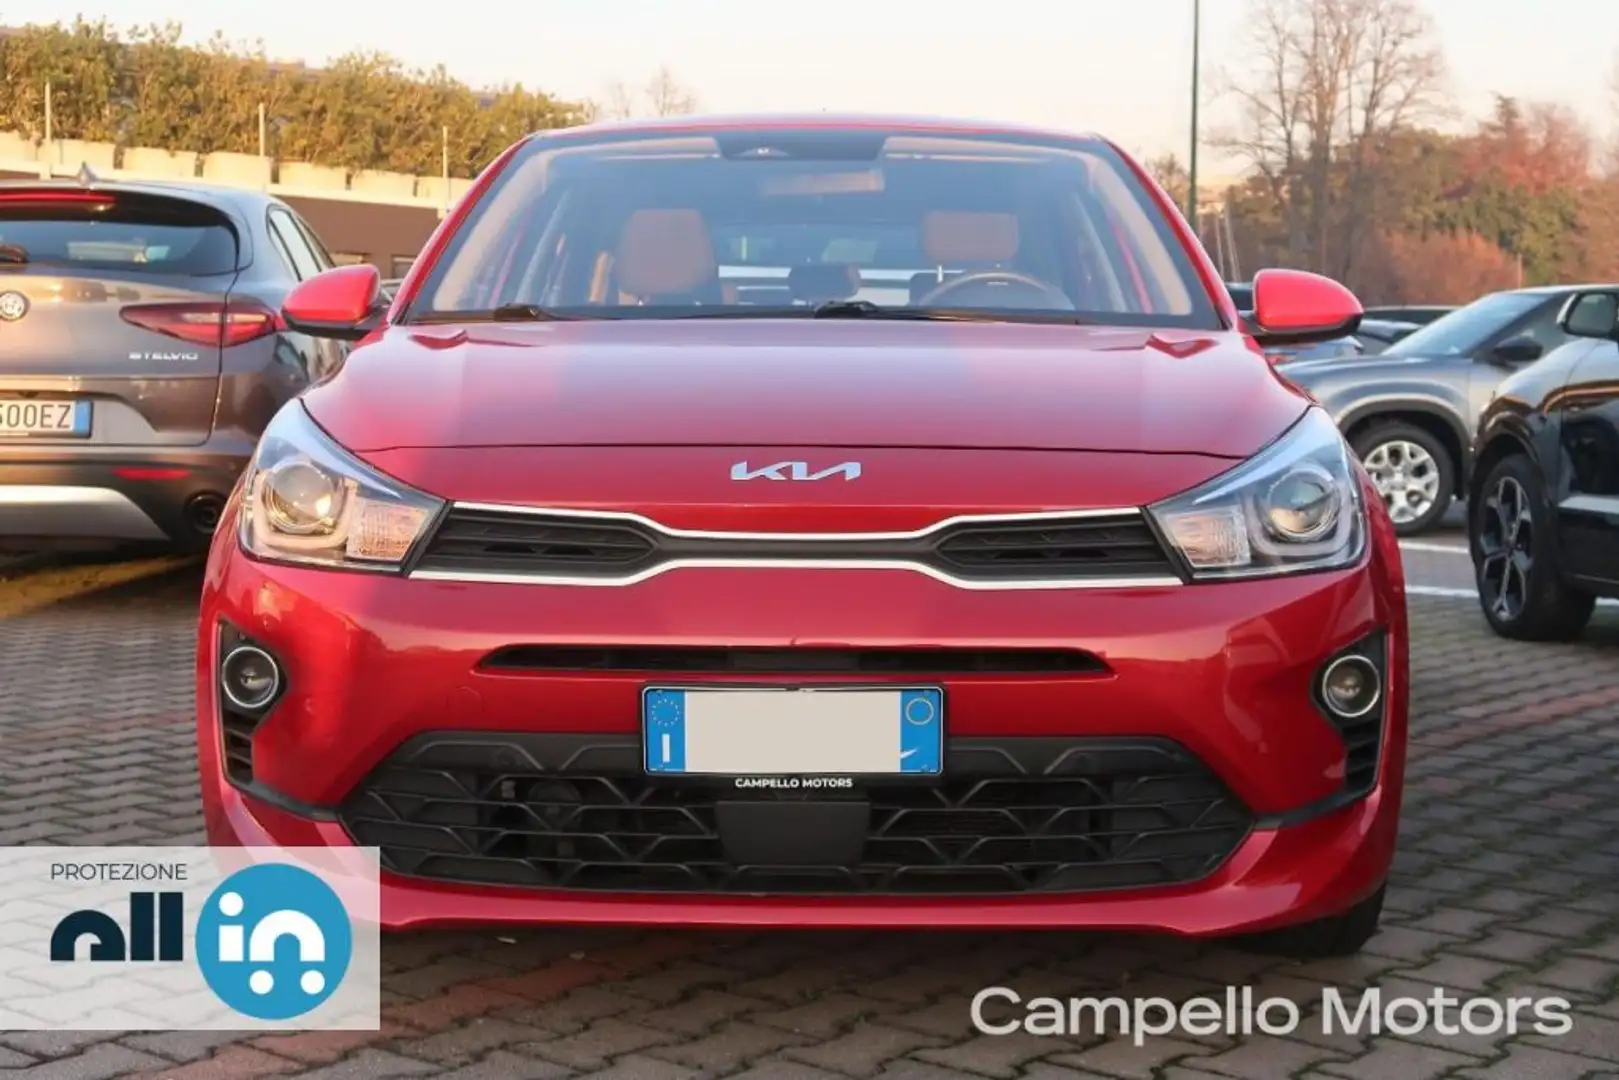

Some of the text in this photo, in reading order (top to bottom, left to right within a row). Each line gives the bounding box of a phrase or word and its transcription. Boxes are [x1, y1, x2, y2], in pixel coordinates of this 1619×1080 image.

[128, 352, 199, 361] STELVIO
[730, 461, 862, 482] KIA
[734, 777, 853, 789] CAMPELLO MOTORS
